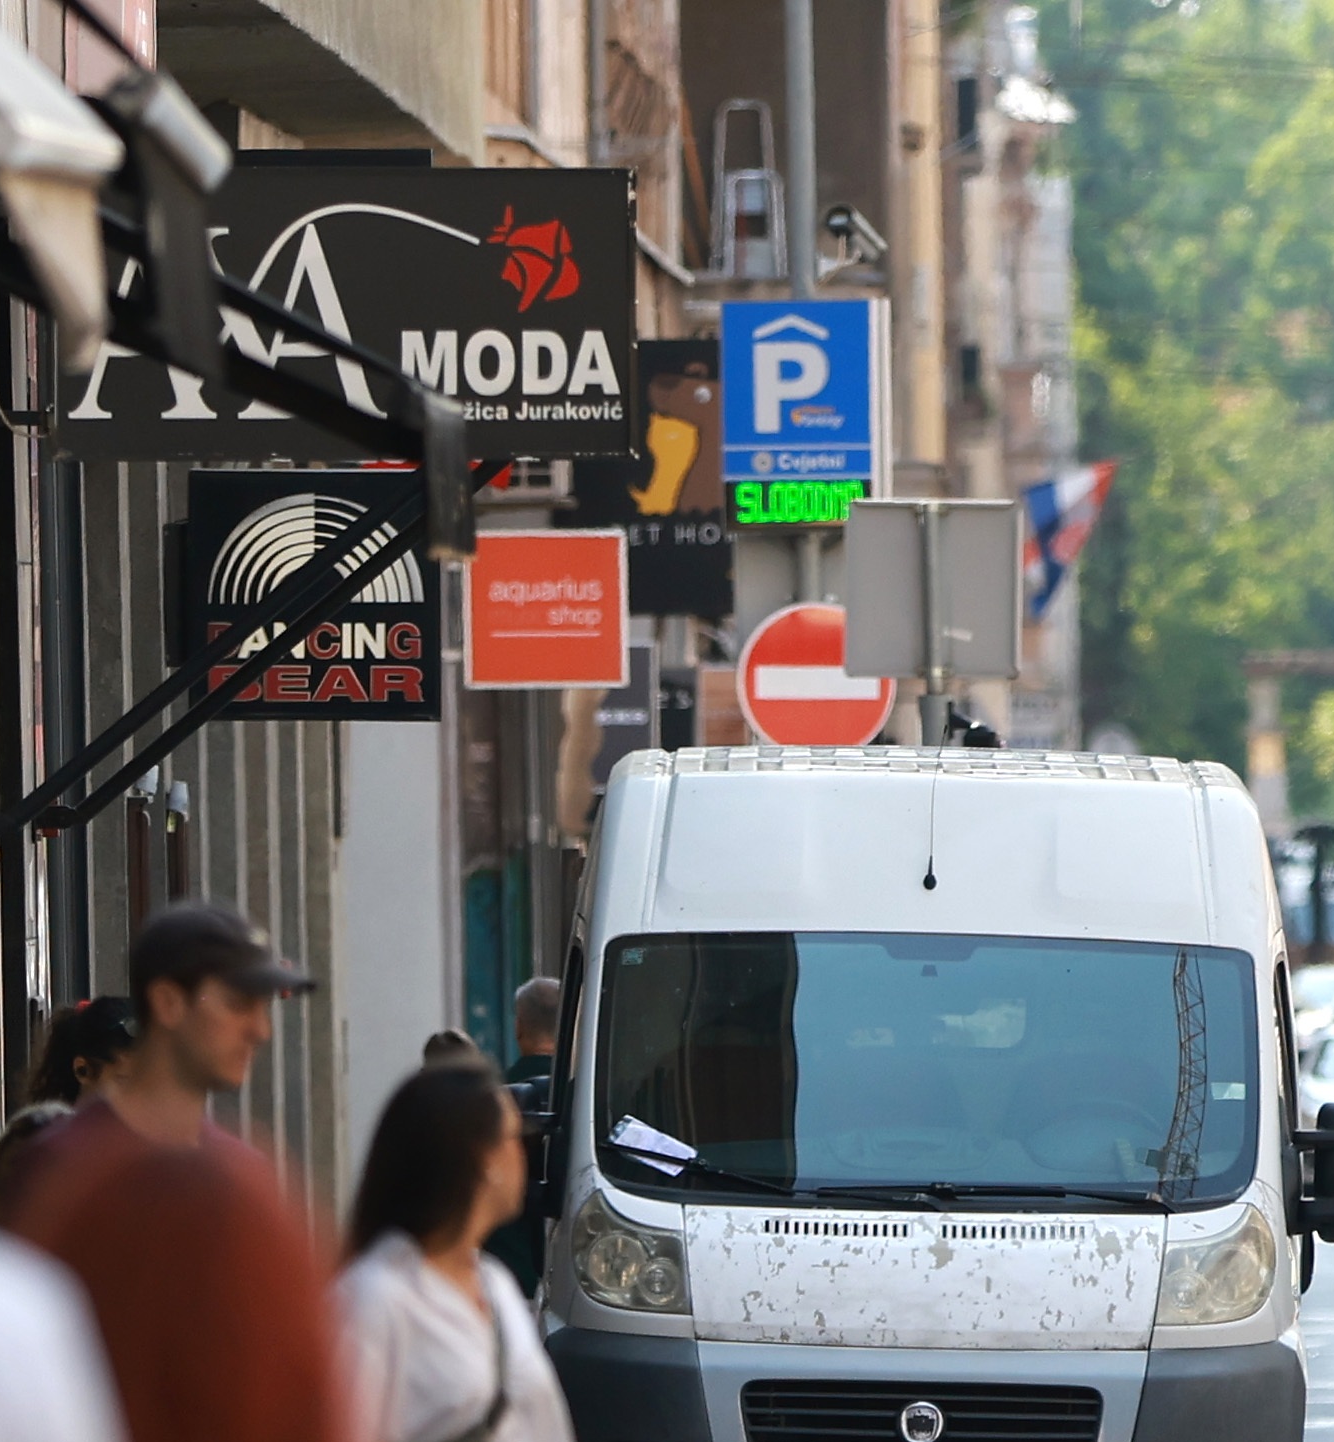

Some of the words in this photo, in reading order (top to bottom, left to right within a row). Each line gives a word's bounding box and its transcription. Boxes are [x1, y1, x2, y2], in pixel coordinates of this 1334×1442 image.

[401, 329, 621, 396] MODA
[753, 342, 830, 434] P
[463, 402, 509, 421] žica
[515, 401, 624, 421] Juraković
[489, 576, 603, 606] aquarius
[548, 606, 603, 629] shop
[208, 665, 424, 702] BEAR
